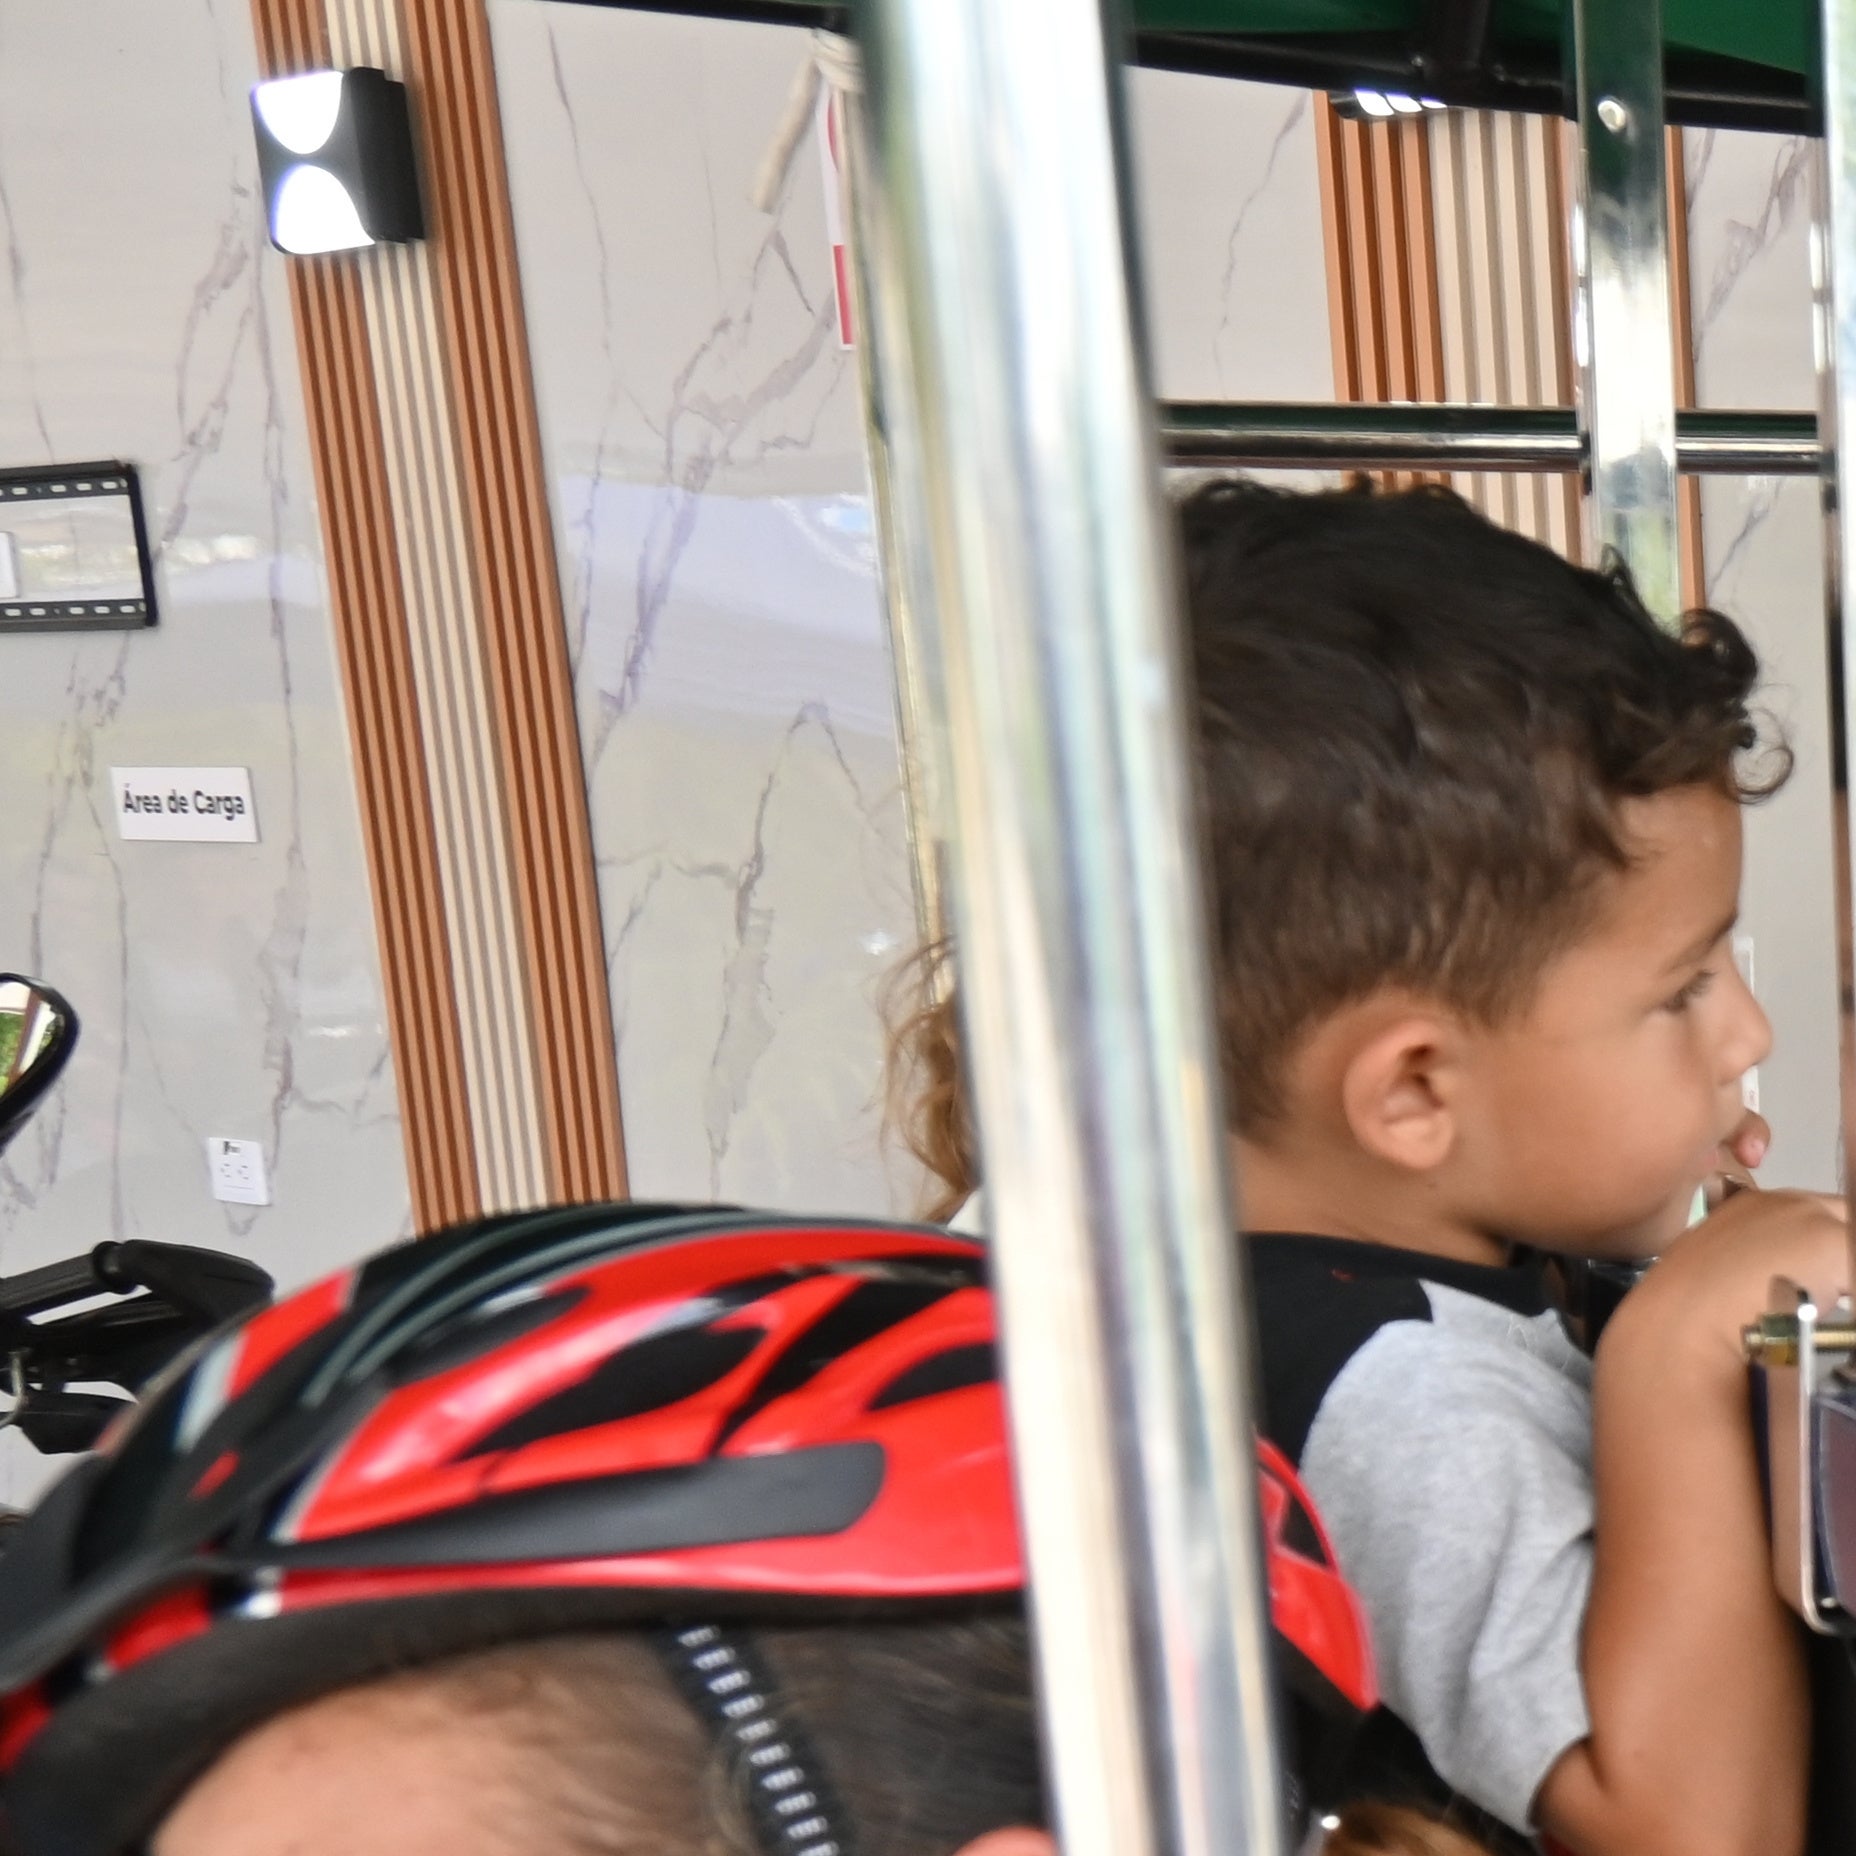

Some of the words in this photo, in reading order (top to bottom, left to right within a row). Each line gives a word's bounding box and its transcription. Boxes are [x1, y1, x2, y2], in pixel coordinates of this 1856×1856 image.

[123, 783, 162, 814] Área
[167, 789, 189, 814] de
[194, 790, 245, 821] Carga
